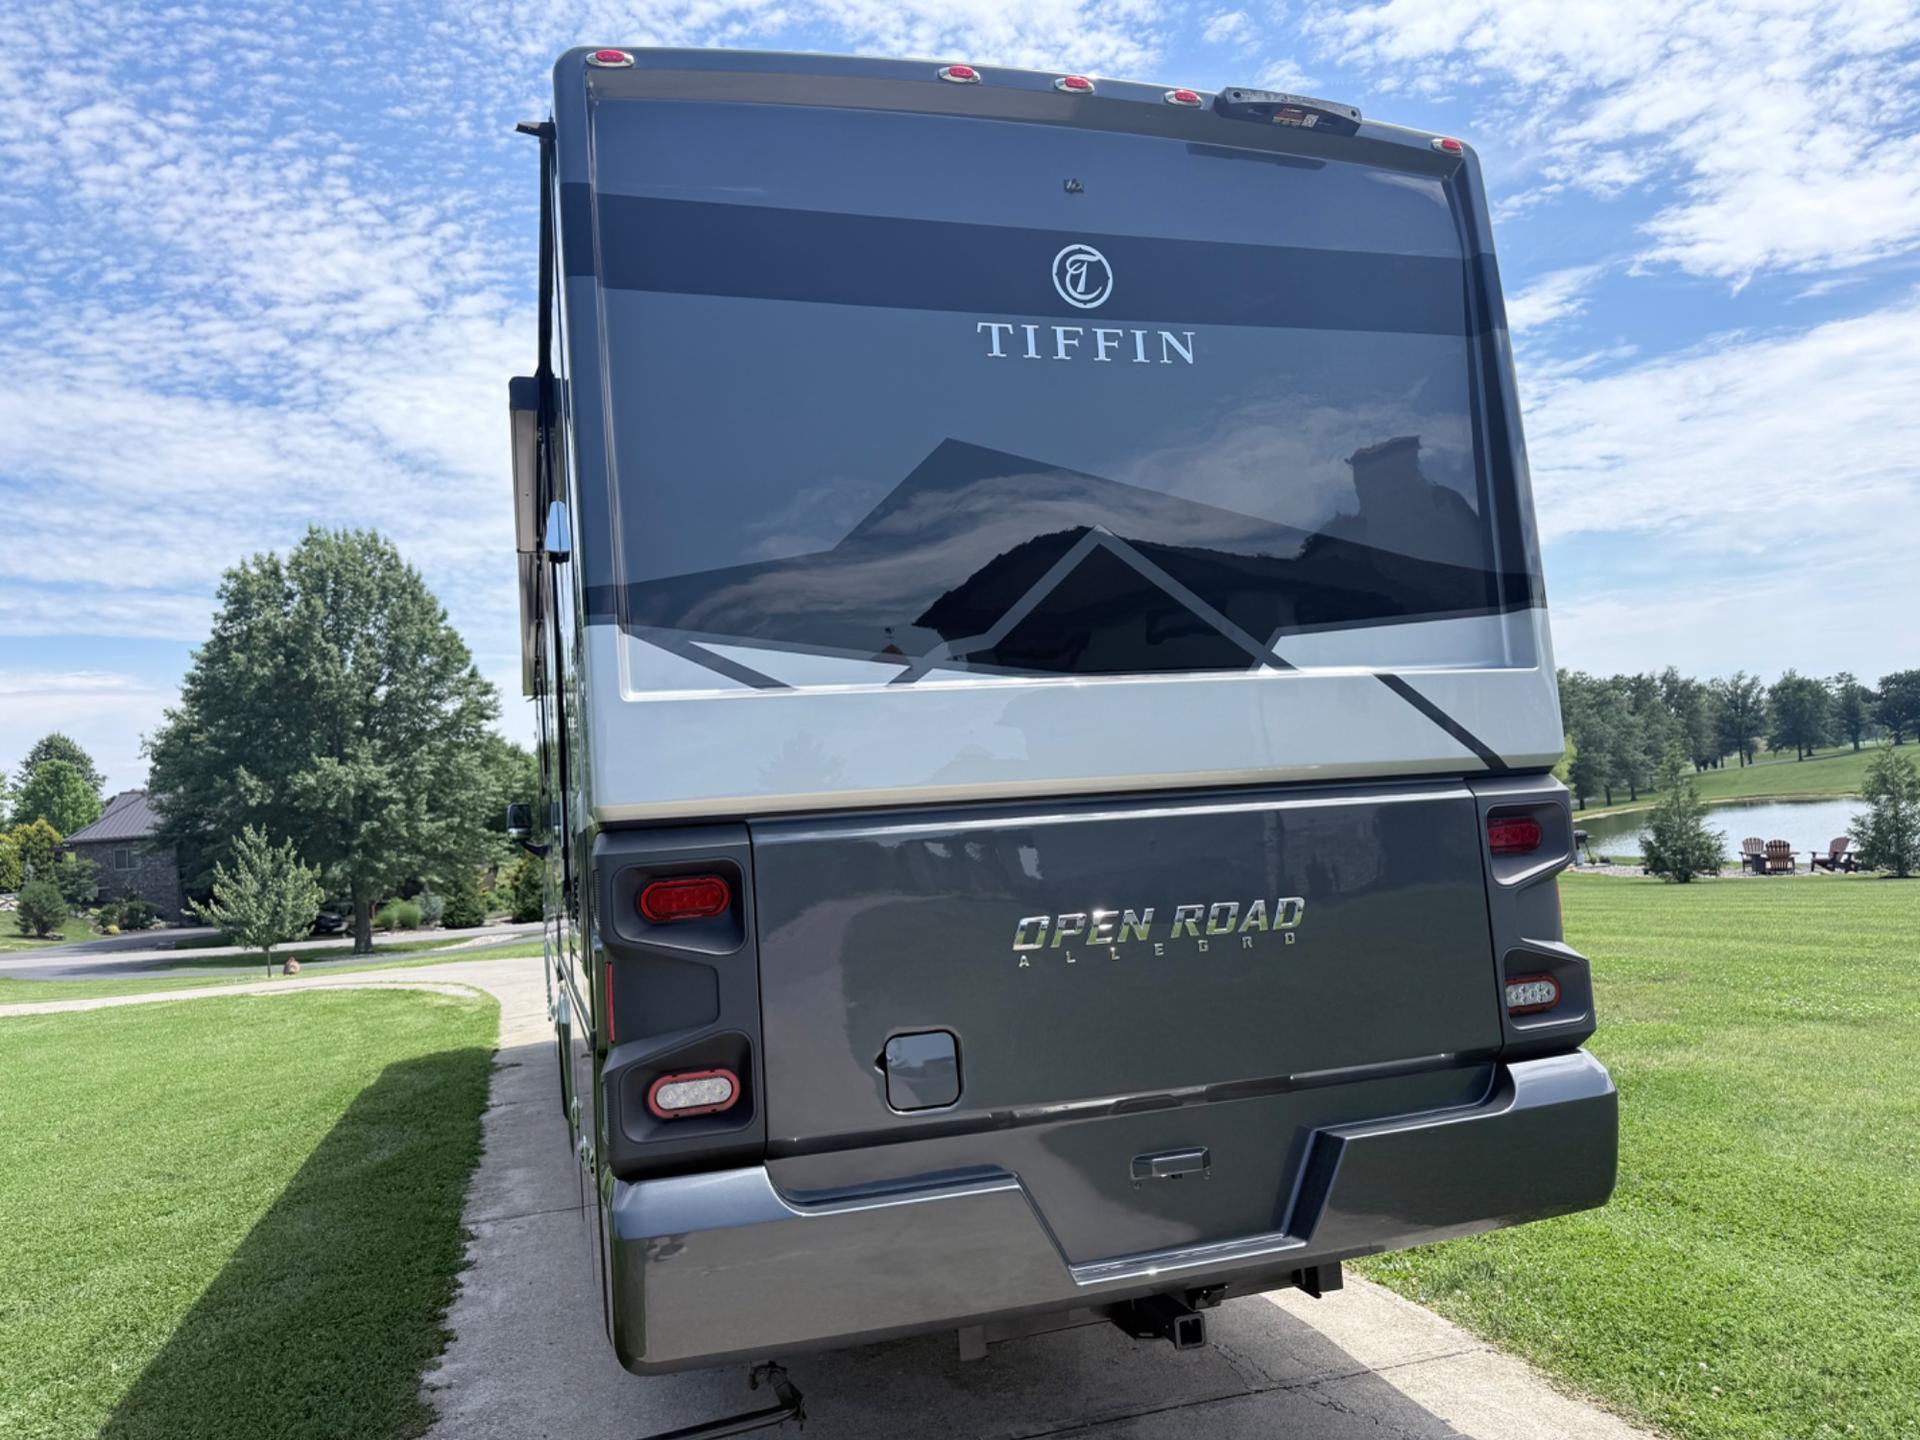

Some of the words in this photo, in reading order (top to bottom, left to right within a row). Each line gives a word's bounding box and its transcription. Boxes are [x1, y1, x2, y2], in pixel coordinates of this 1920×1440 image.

[976, 321, 1196, 364] TIFFIN
[1012, 907, 1155, 950] OPEN
[1170, 896, 1305, 939] ROAD
[1018, 931, 1296, 968] ALLEGRO
